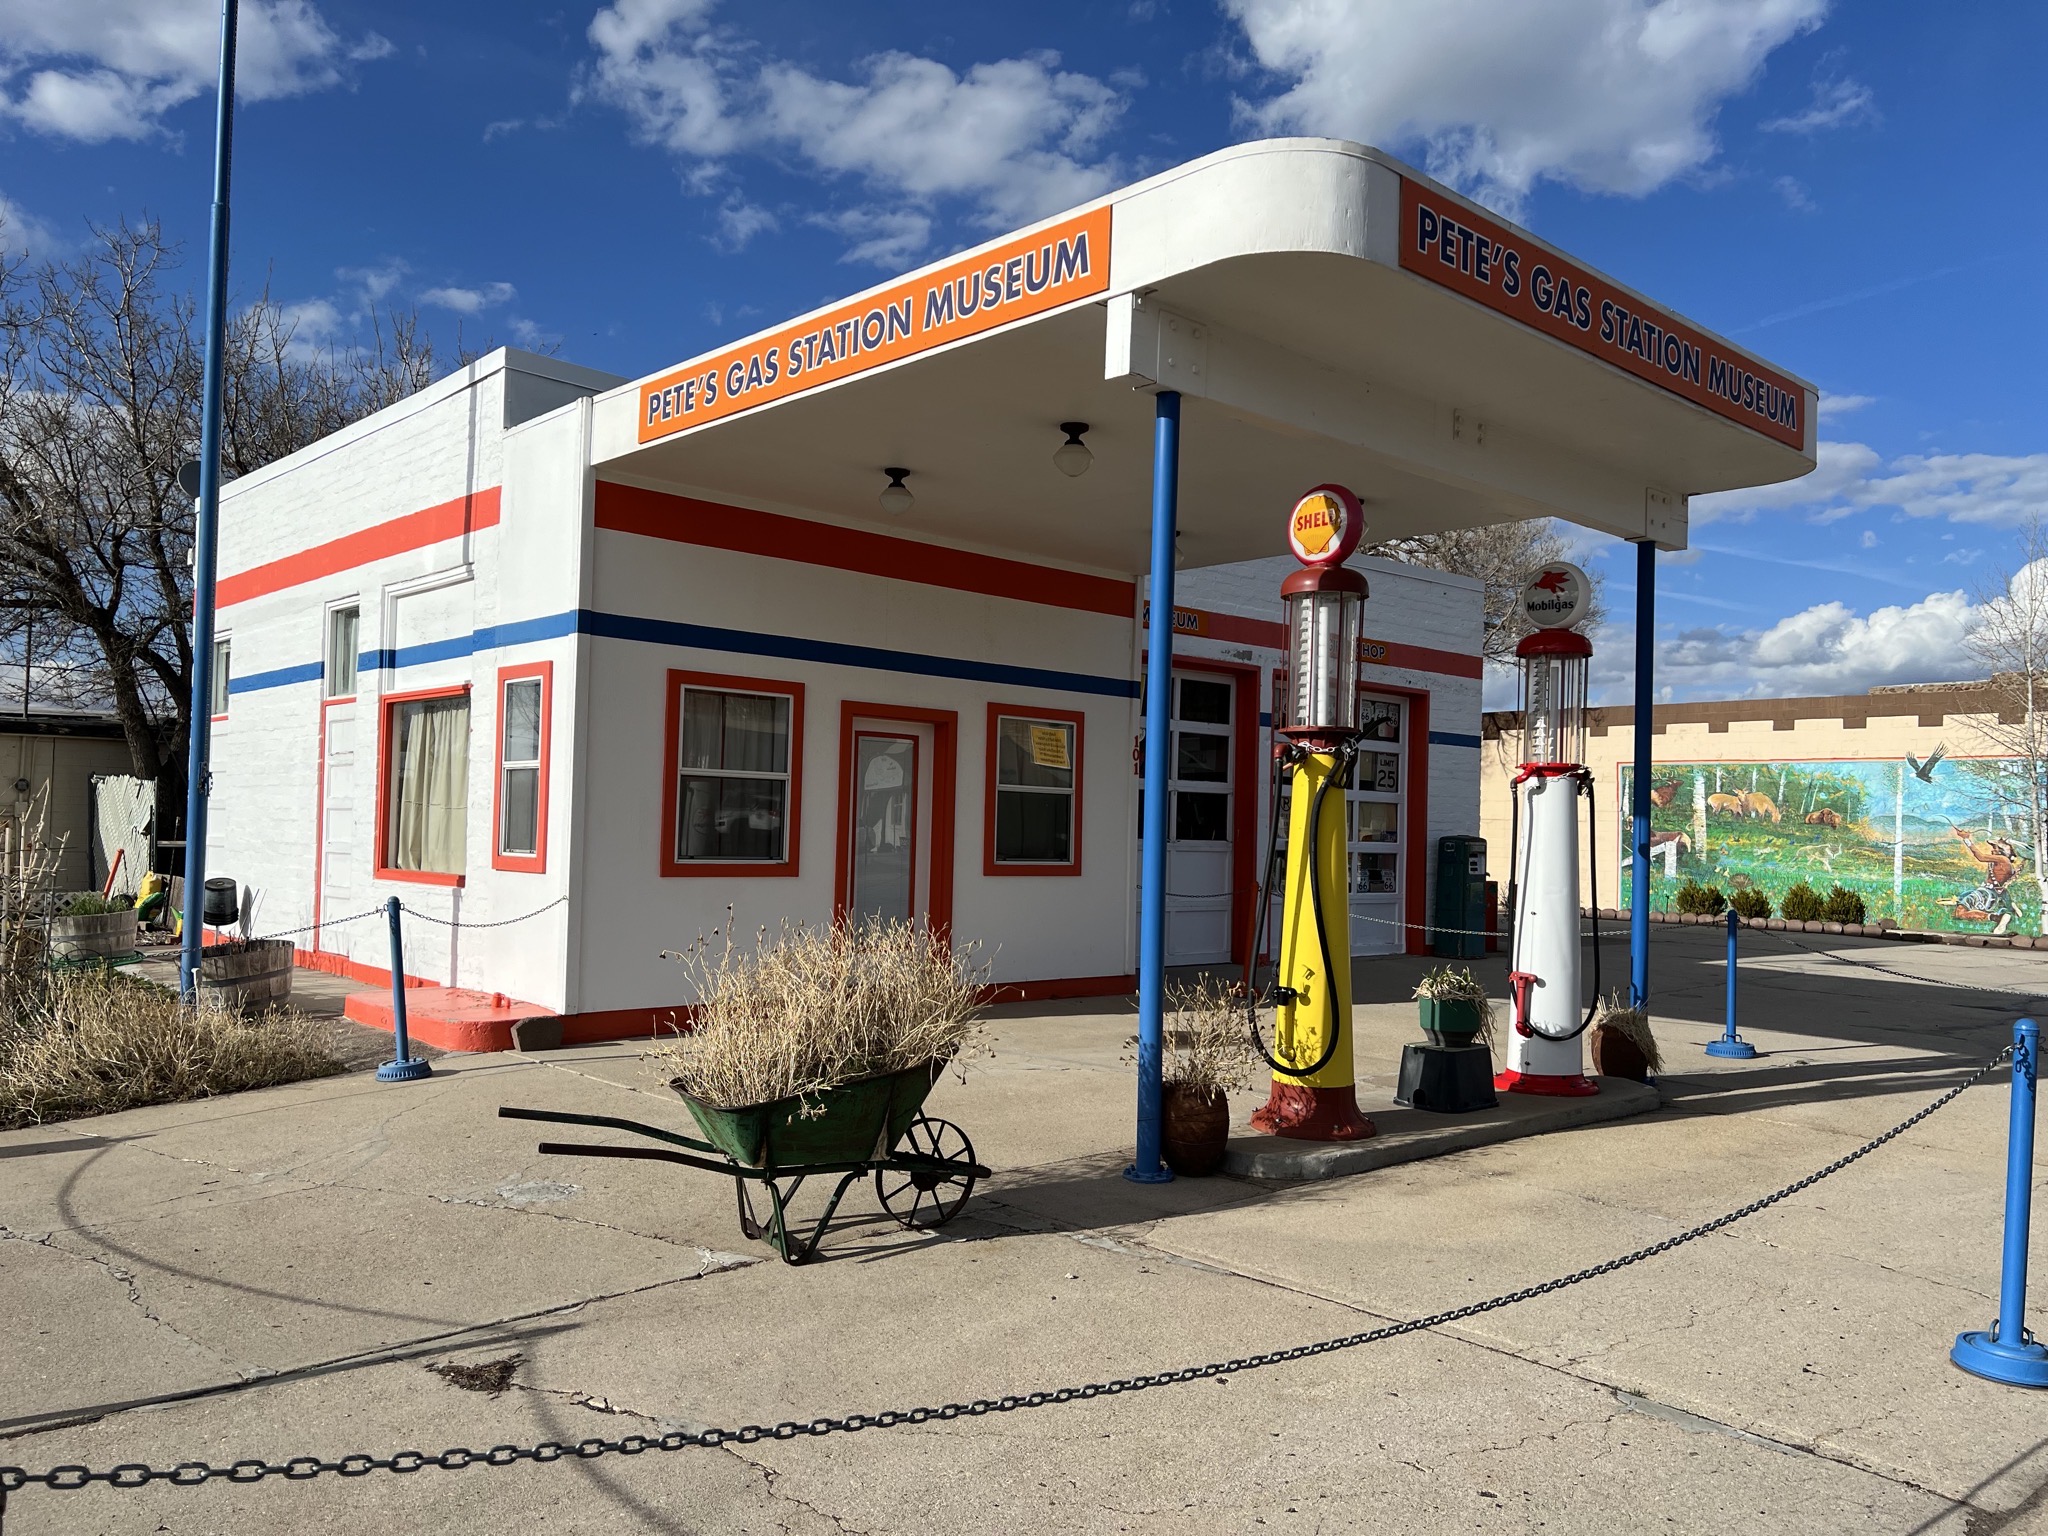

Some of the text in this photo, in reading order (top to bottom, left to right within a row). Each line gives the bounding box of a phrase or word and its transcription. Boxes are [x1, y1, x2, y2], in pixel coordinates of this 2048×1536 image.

[1417, 204, 1798, 431] PETE'S GAS STATION MUSEUM
[647, 233, 1090, 426] PETE'S GAS STATION MUSEUM
[1526, 599, 1574, 613] Mobilgas
[1361, 712, 1370, 721] 66
[1389, 717, 1398, 725] 66
[1380, 759, 1395, 767] LIMIT
[1377, 769, 1396, 788] 25
[1358, 881, 1368, 890] 66
[1384, 881, 1394, 890] 66
